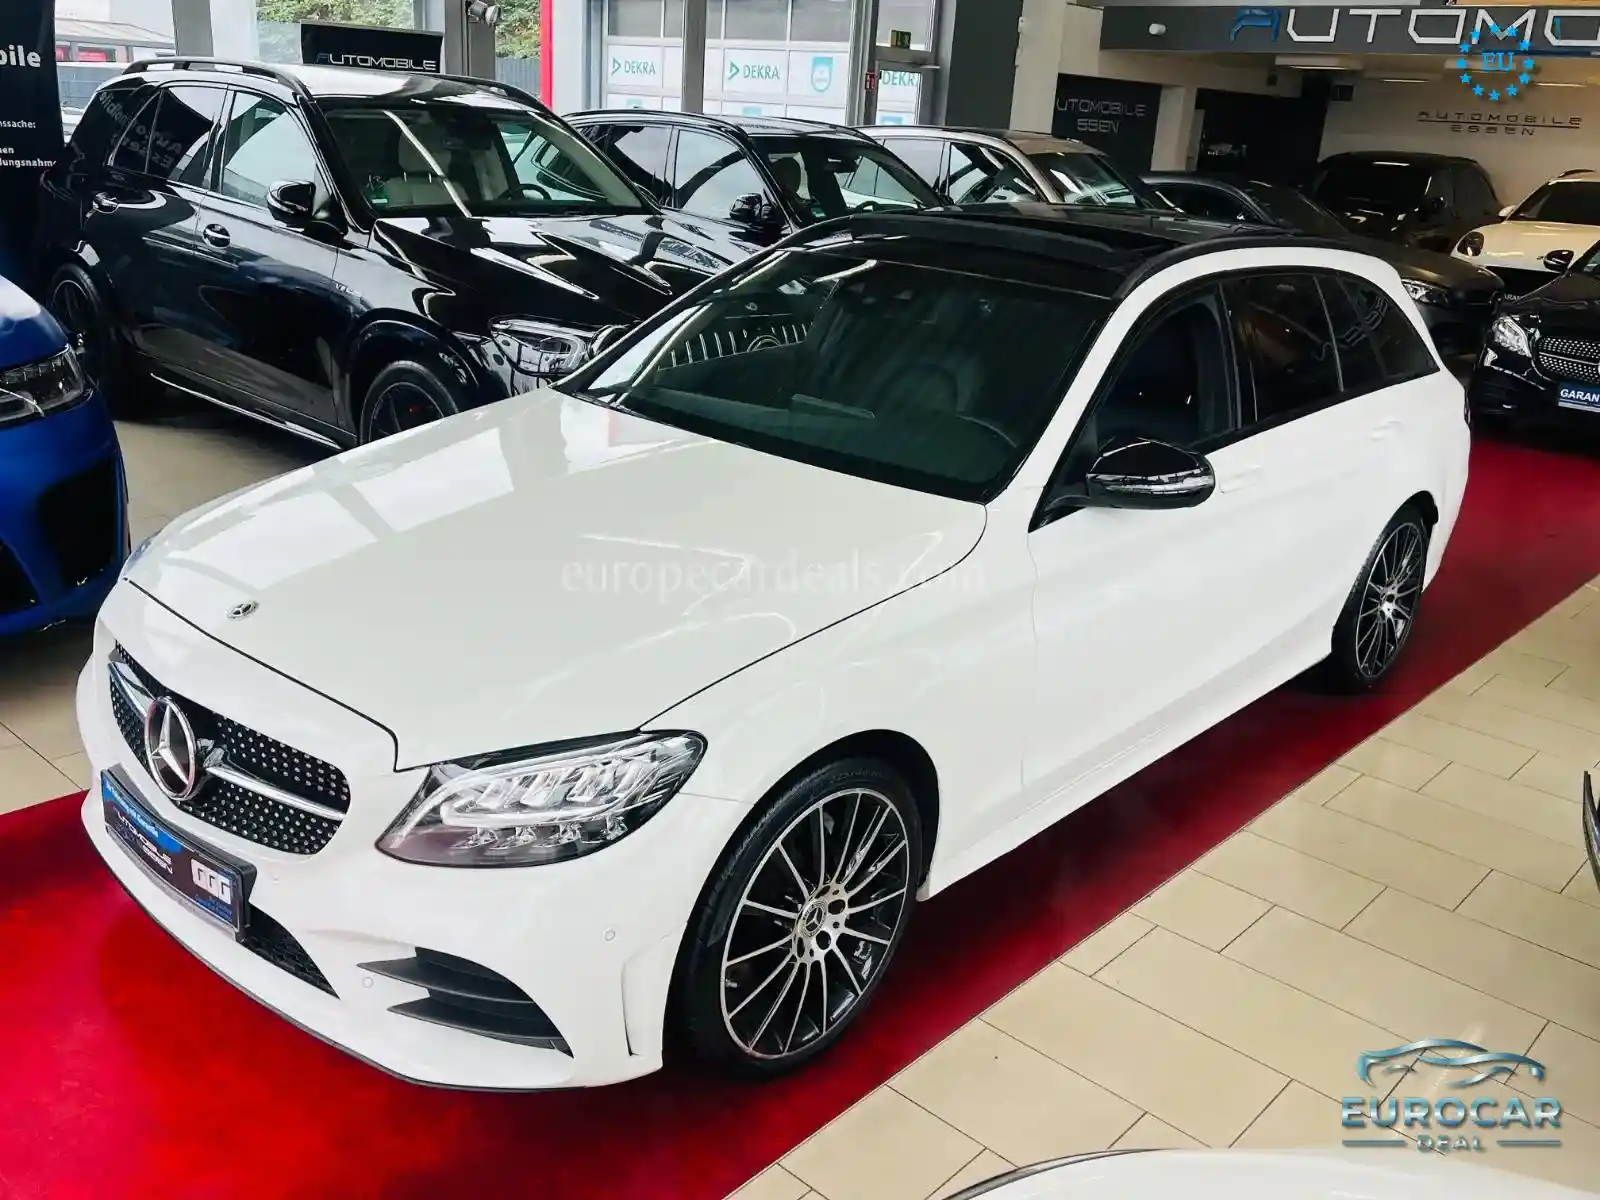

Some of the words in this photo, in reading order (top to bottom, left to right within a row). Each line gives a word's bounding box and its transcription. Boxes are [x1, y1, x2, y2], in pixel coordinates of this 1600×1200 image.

[1229, 8, 1600, 46] AUTOMO
[316, 52, 437, 71] AUTOMOBILE
[624, 60, 656, 75] DEKRA
[743, 64, 780, 80] DEKRA
[882, 71, 919, 87] DEKR
[1056, 97, 1147, 117] UTOMOBILE
[1076, 117, 1120, 134] SSEN
[1416, 109, 1583, 126] AUTOMOBILE
[1450, 124, 1536, 136] ESSEN
